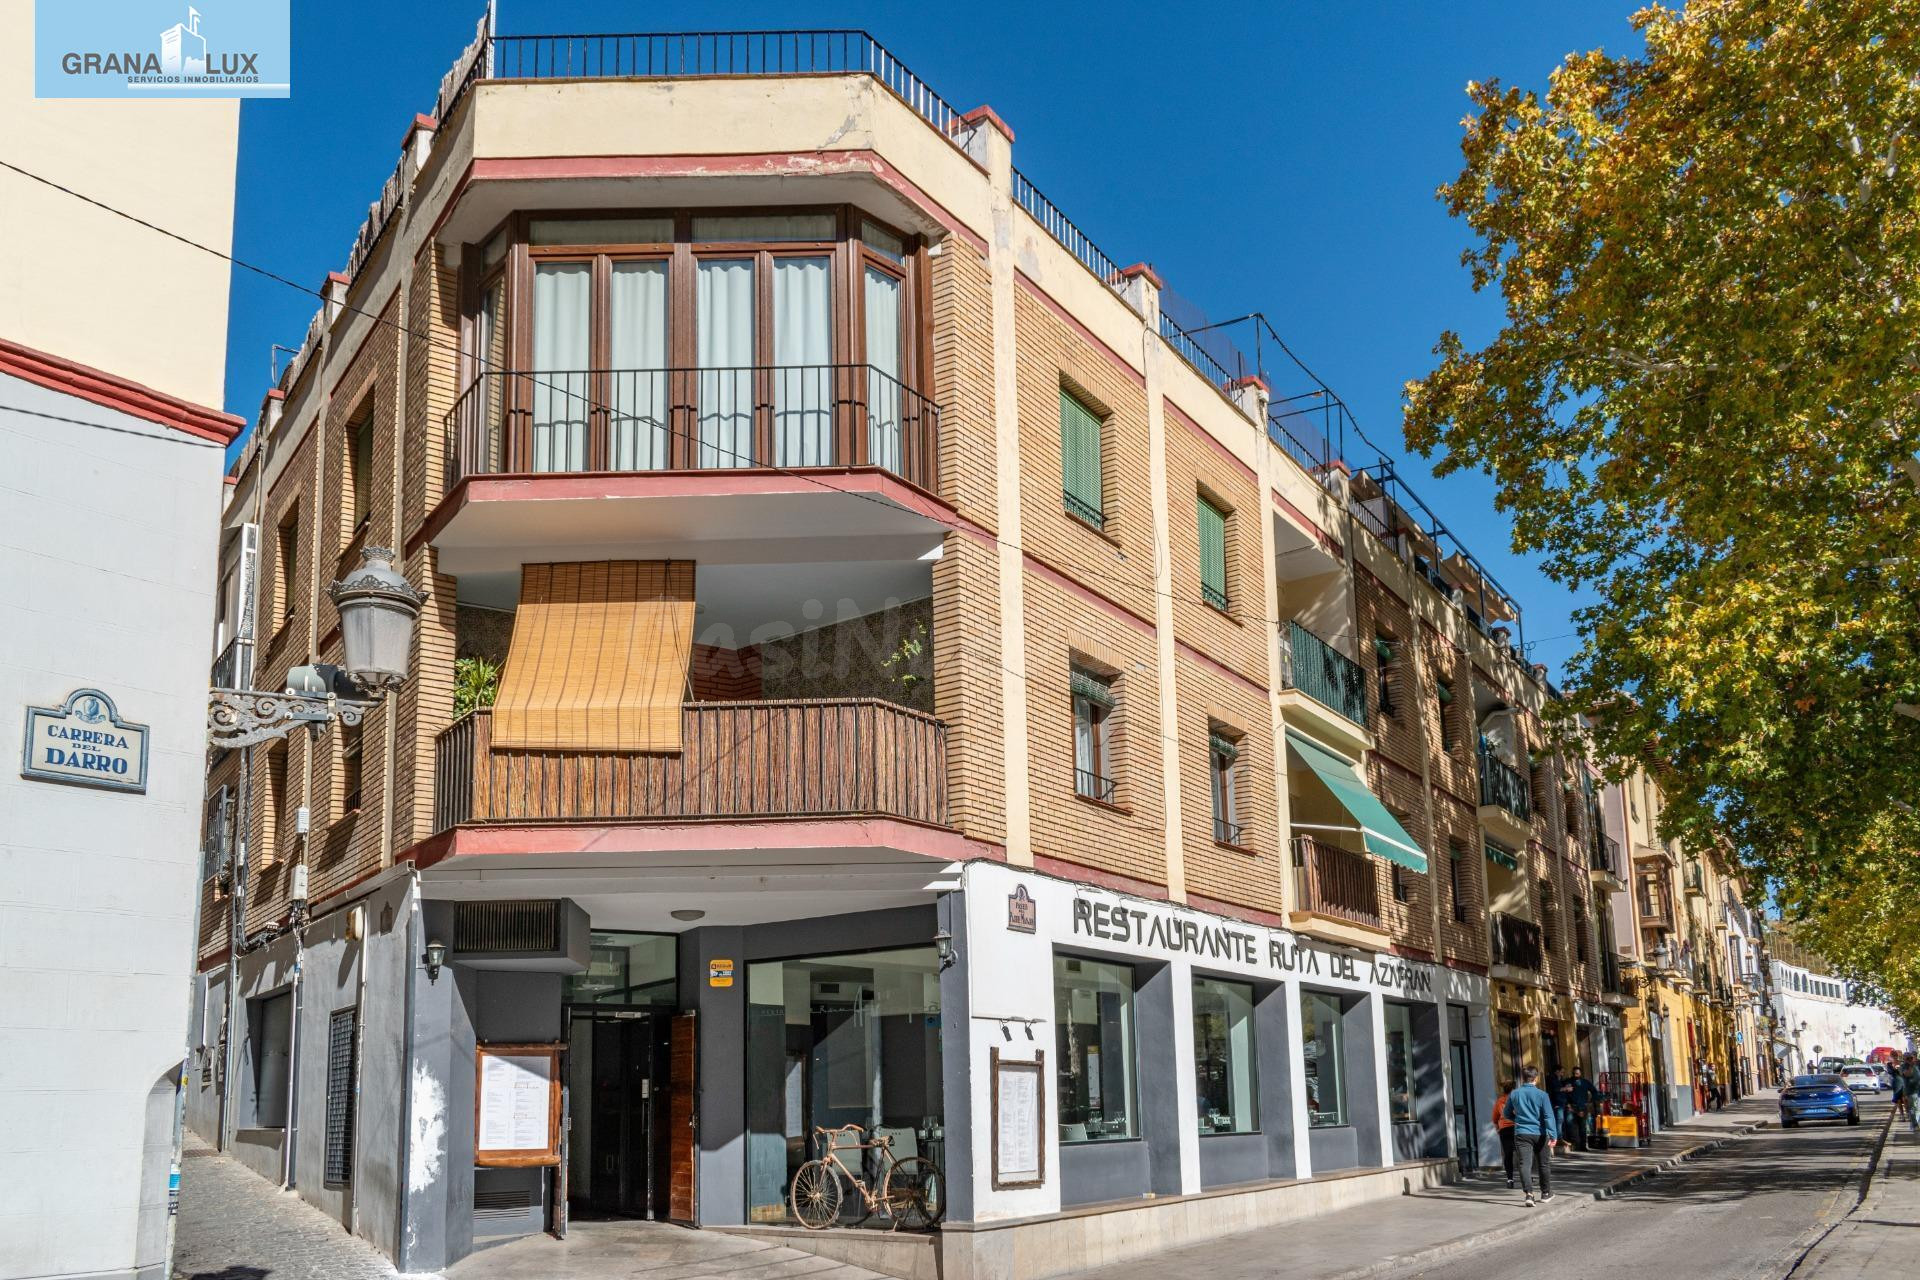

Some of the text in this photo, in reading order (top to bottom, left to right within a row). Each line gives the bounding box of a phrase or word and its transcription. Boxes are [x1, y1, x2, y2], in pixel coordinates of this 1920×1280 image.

[47, 725, 129, 749] CARRERA
[72, 743, 101, 752] DEL
[45, 747, 128, 775] DARRO
[1073, 897, 1257, 965] RESTAURANTE
[1269, 940, 1320, 976] RUTA
[1330, 952, 1360, 982] DEL
[1369, 961, 1432, 993] AZAFRAN
